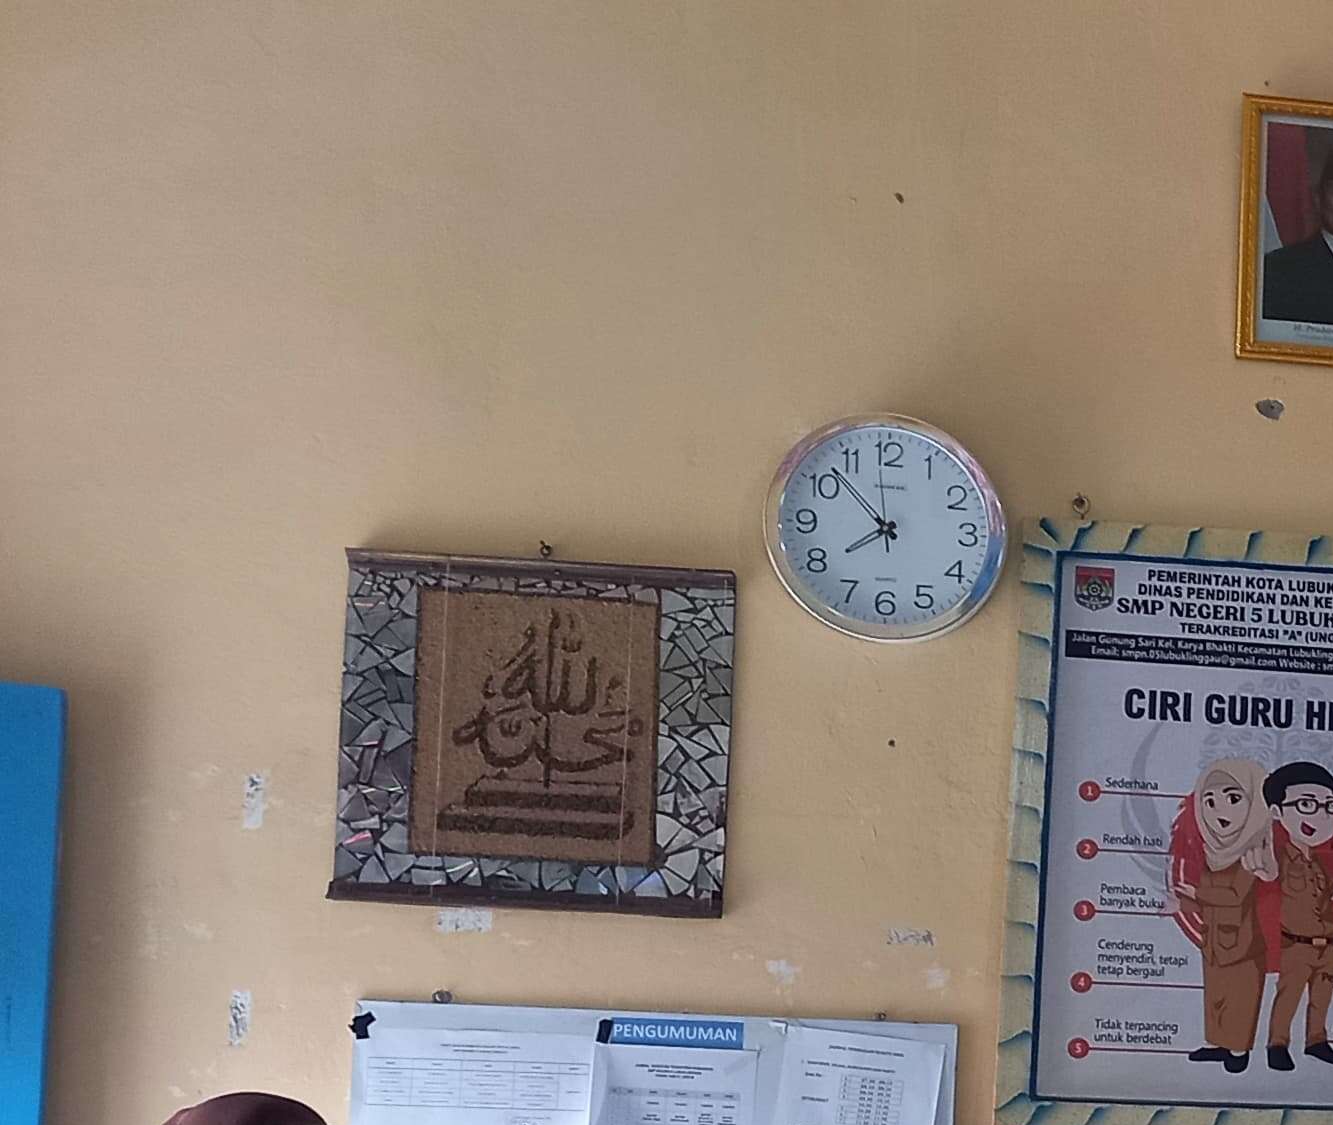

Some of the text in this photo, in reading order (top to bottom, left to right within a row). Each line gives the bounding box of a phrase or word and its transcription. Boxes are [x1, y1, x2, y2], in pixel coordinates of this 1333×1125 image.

[842, 448, 860, 474] 11
[875, 440, 904, 468] 12
[924, 455, 932, 480] 1
[809, 472, 840, 500] 10
[947, 485, 968, 511] 2
[795, 508, 817, 534] 9
[958, 523, 978, 547] 3
[806, 548, 827, 573] 8
[944, 560, 965, 584] 4
[840, 579, 859, 603] 7
[1148, 569, 1241, 588] PEMERINTAH
[1246, 577, 1284, 592] KOTA
[875, 591, 896, 616] 6
[914, 585, 934, 609] 5
[1138, 583, 1182, 598] DINAS
[1187, 587, 1275, 605] PENDIDIKAN
[1281, 594, 1309, 608] DAN
[1117, 598, 1164, 616] SMP
[1169, 602, 1245, 622] NEGERI
[1251, 608, 1262, 624] 5
[1180, 622, 1279, 639] TERAKREDITASI
[1072, 632, 1096, 644] Jalan
[1098, 634, 1136, 649] Gunung
[1138, 637, 1155, 648] Sari
[1177, 640, 1203, 653] Karya
[1206, 642, 1236, 653] Bhakti
[1238, 644, 1287, 657] Kecamatan
[1279, 658, 1315, 670] Website
[1124, 688, 1192, 722] CIRI
[1204, 693, 1293, 730] GURU
[1105, 777, 1158, 791] Sederhana
[1103, 834, 1141, 847] Rendah
[1100, 884, 1147, 897] Pembaca
[1100, 896, 1165, 911] banyak buku
[1098, 939, 1154, 954] Cenderung
[1097, 965, 1165, 979] tetap bergaul
[1159, 956, 1188, 968] tetapi
[613, 1023, 737, 1042] PENGUMUMAN
[1095, 1018, 1179, 1034] Tidak terpancing
[1094, 1032, 1172, 1045] untuk berdebat
